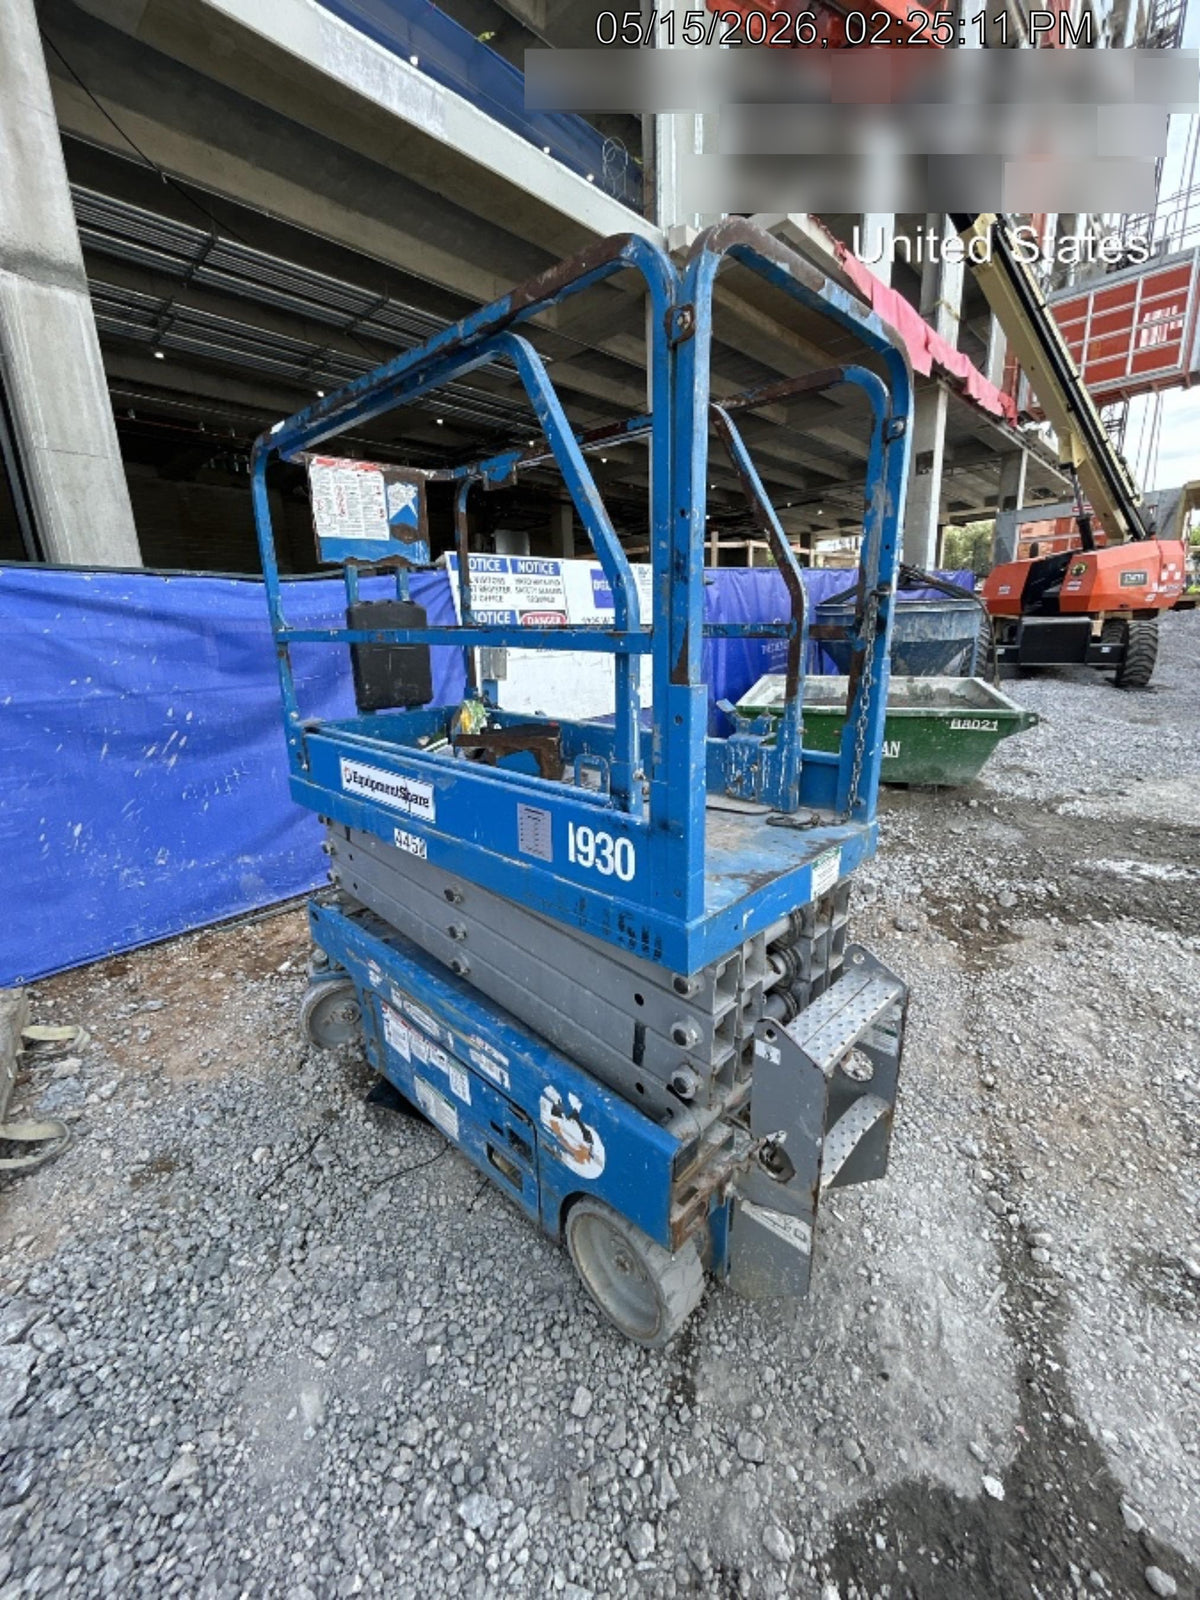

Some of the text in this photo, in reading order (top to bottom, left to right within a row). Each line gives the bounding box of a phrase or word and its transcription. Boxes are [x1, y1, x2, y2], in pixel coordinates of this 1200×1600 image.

[469, 558, 502, 571] OTICE
[517, 561, 555, 574] NOTICE
[882, 741, 900, 758] AN
[568, 821, 635, 881] 1930
